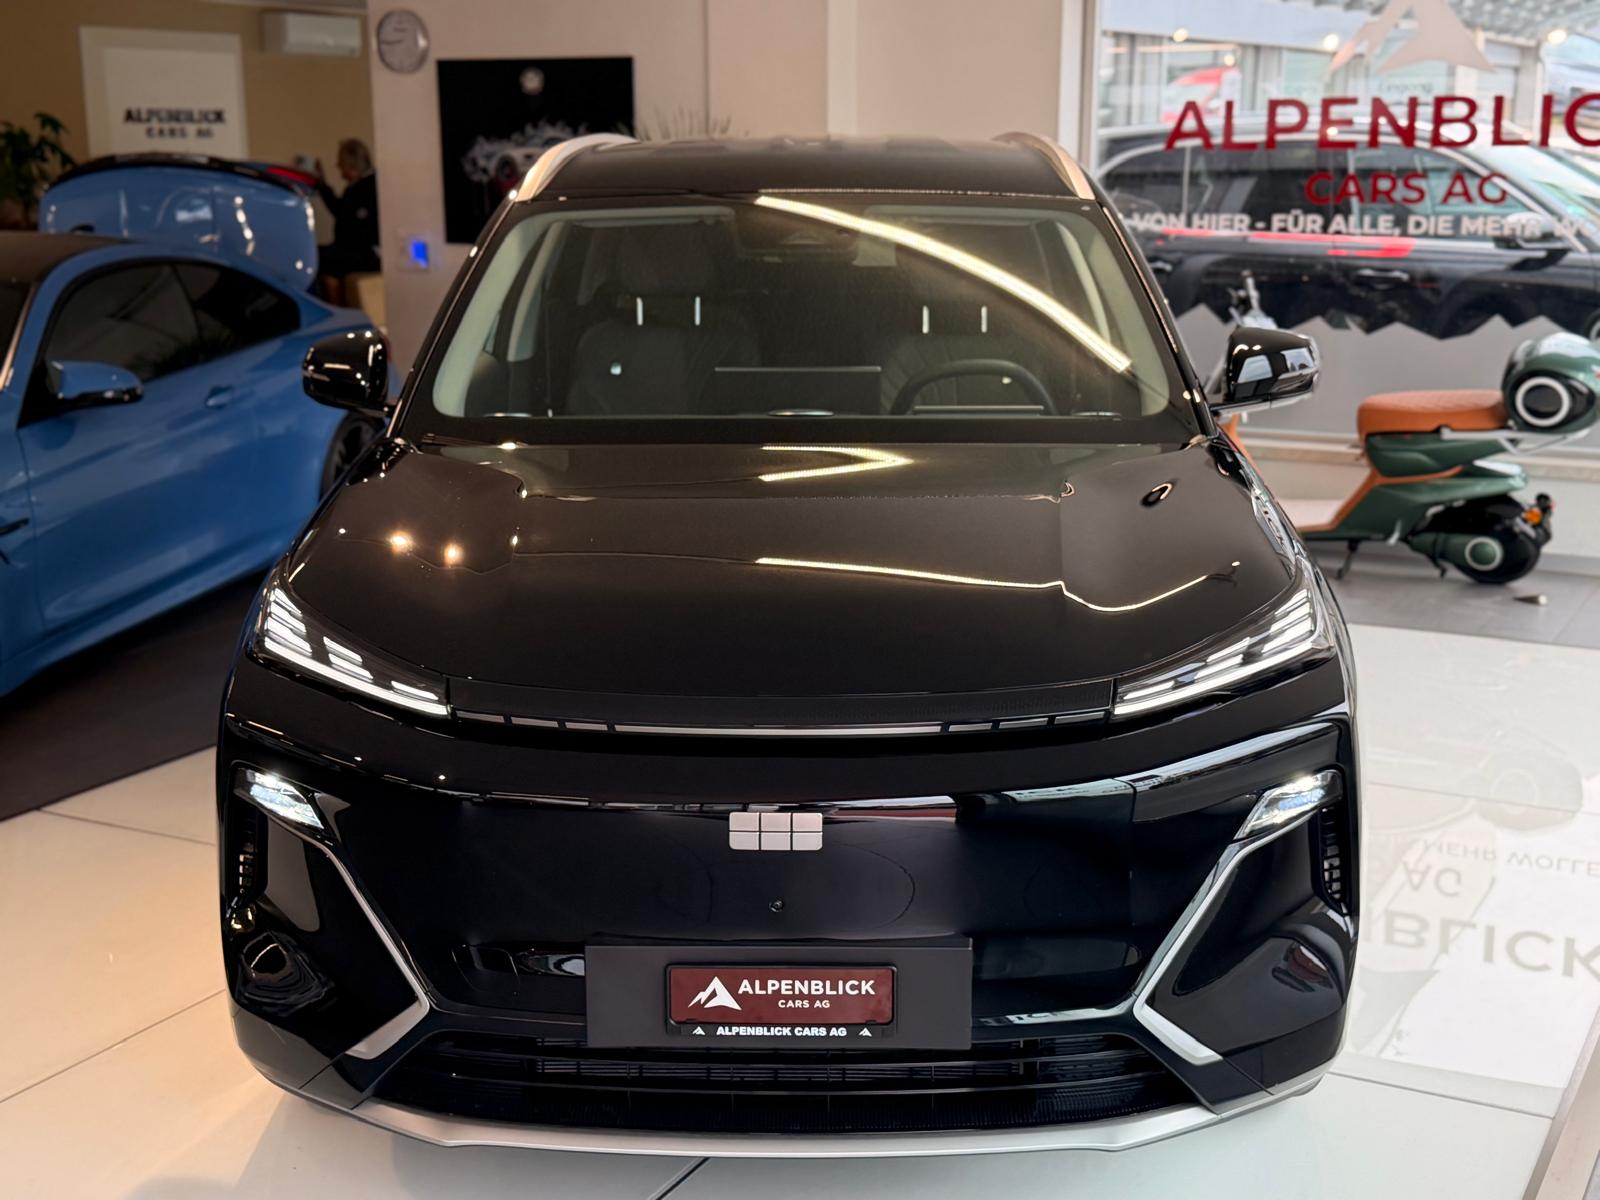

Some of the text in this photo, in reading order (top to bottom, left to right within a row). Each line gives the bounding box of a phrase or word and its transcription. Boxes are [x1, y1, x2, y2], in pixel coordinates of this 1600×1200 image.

[1304, 171, 1509, 206] CARS AG
[1129, 211, 1188, 233] VON
[1191, 211, 1251, 234] HIER
[1270, 208, 1324, 235] FÜR
[1327, 212, 1400, 237] ALLE,
[1407, 214, 1455, 237] DIE
[1460, 215, 1541, 239] MEHR
[738, 979, 876, 996] ALPENBLICK
[778, 999, 831, 1009] CARS AG
[716, 1026, 848, 1037] ALPENBLICK CARS AG
